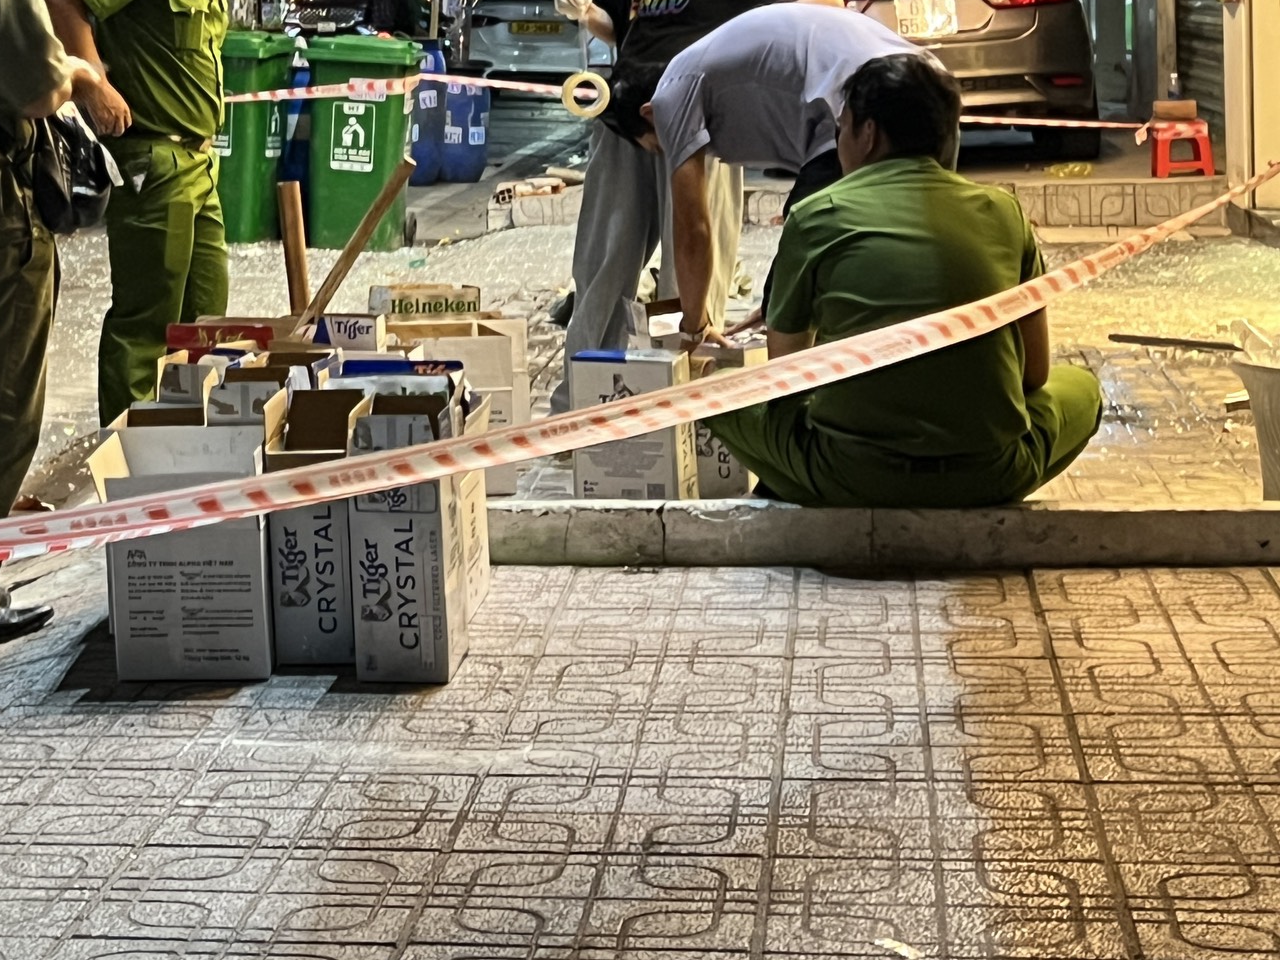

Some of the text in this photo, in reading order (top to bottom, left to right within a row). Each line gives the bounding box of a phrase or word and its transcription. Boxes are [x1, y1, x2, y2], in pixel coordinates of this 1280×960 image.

[335, 320, 373, 340] Tiger
[391, 298, 477, 314] Heineken
[278, 526, 307, 585] Tiger
[313, 505, 337, 634] CRYSTAL
[359, 538, 388, 599] Tiger
[393, 518, 419, 649] CRYSTAL
